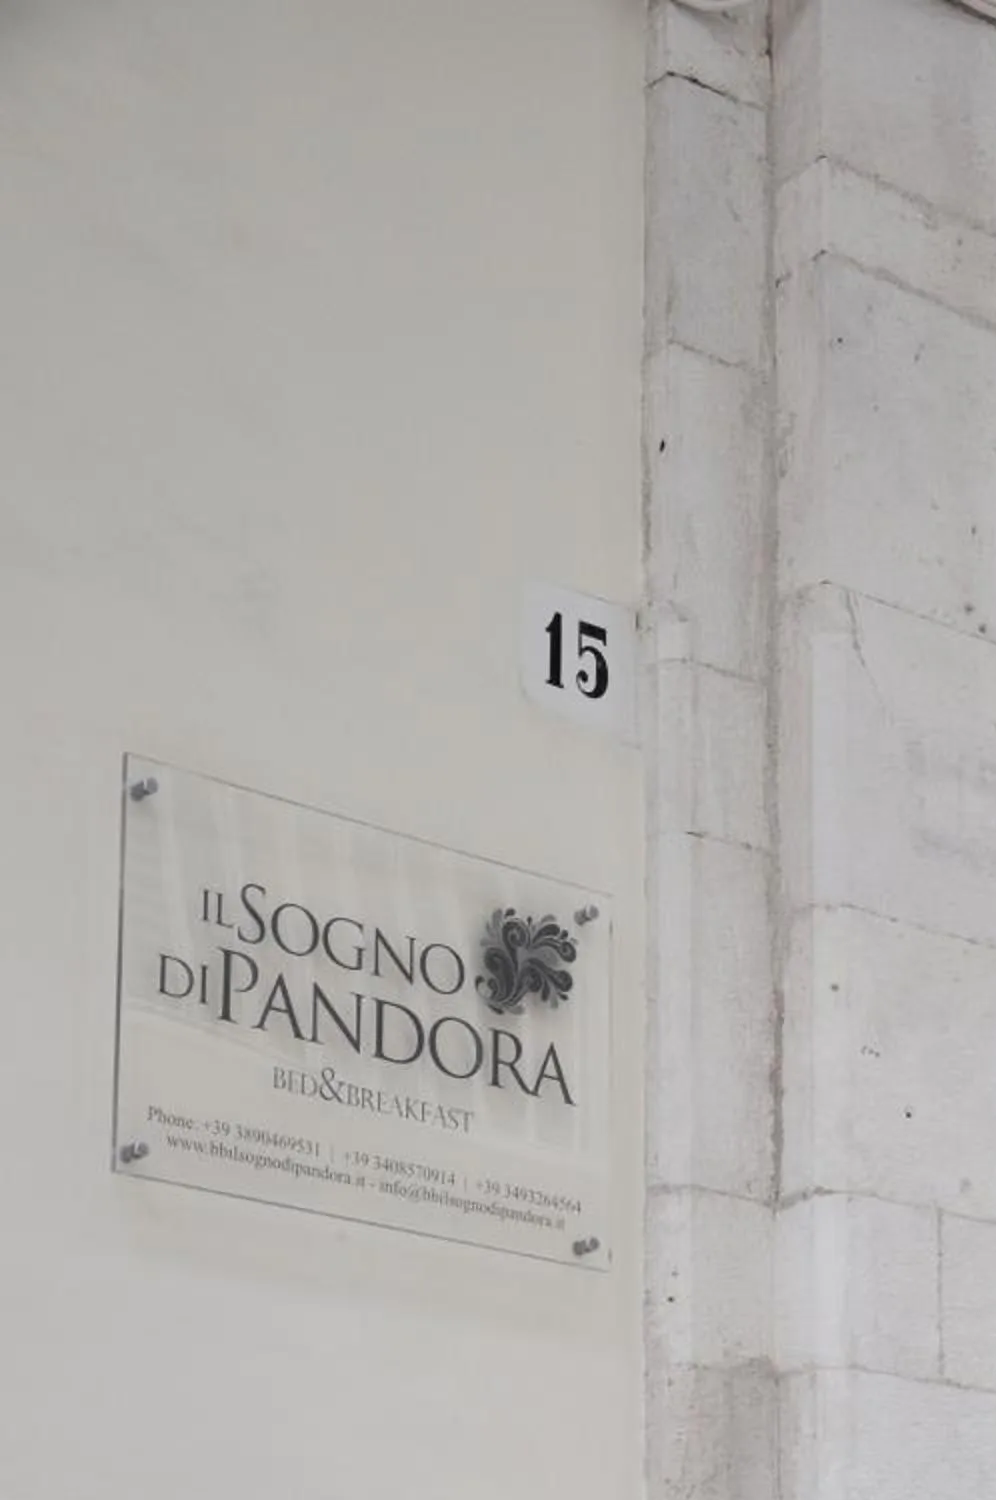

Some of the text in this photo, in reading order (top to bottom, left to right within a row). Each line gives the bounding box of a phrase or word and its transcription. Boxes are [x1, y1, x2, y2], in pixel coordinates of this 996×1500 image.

[545, 611, 609, 699] 15
[237, 883, 465, 995] SOGNO
[217, 947, 576, 1106] PANDORA
[273, 1066, 475, 1133] BED&BREAKFAST
